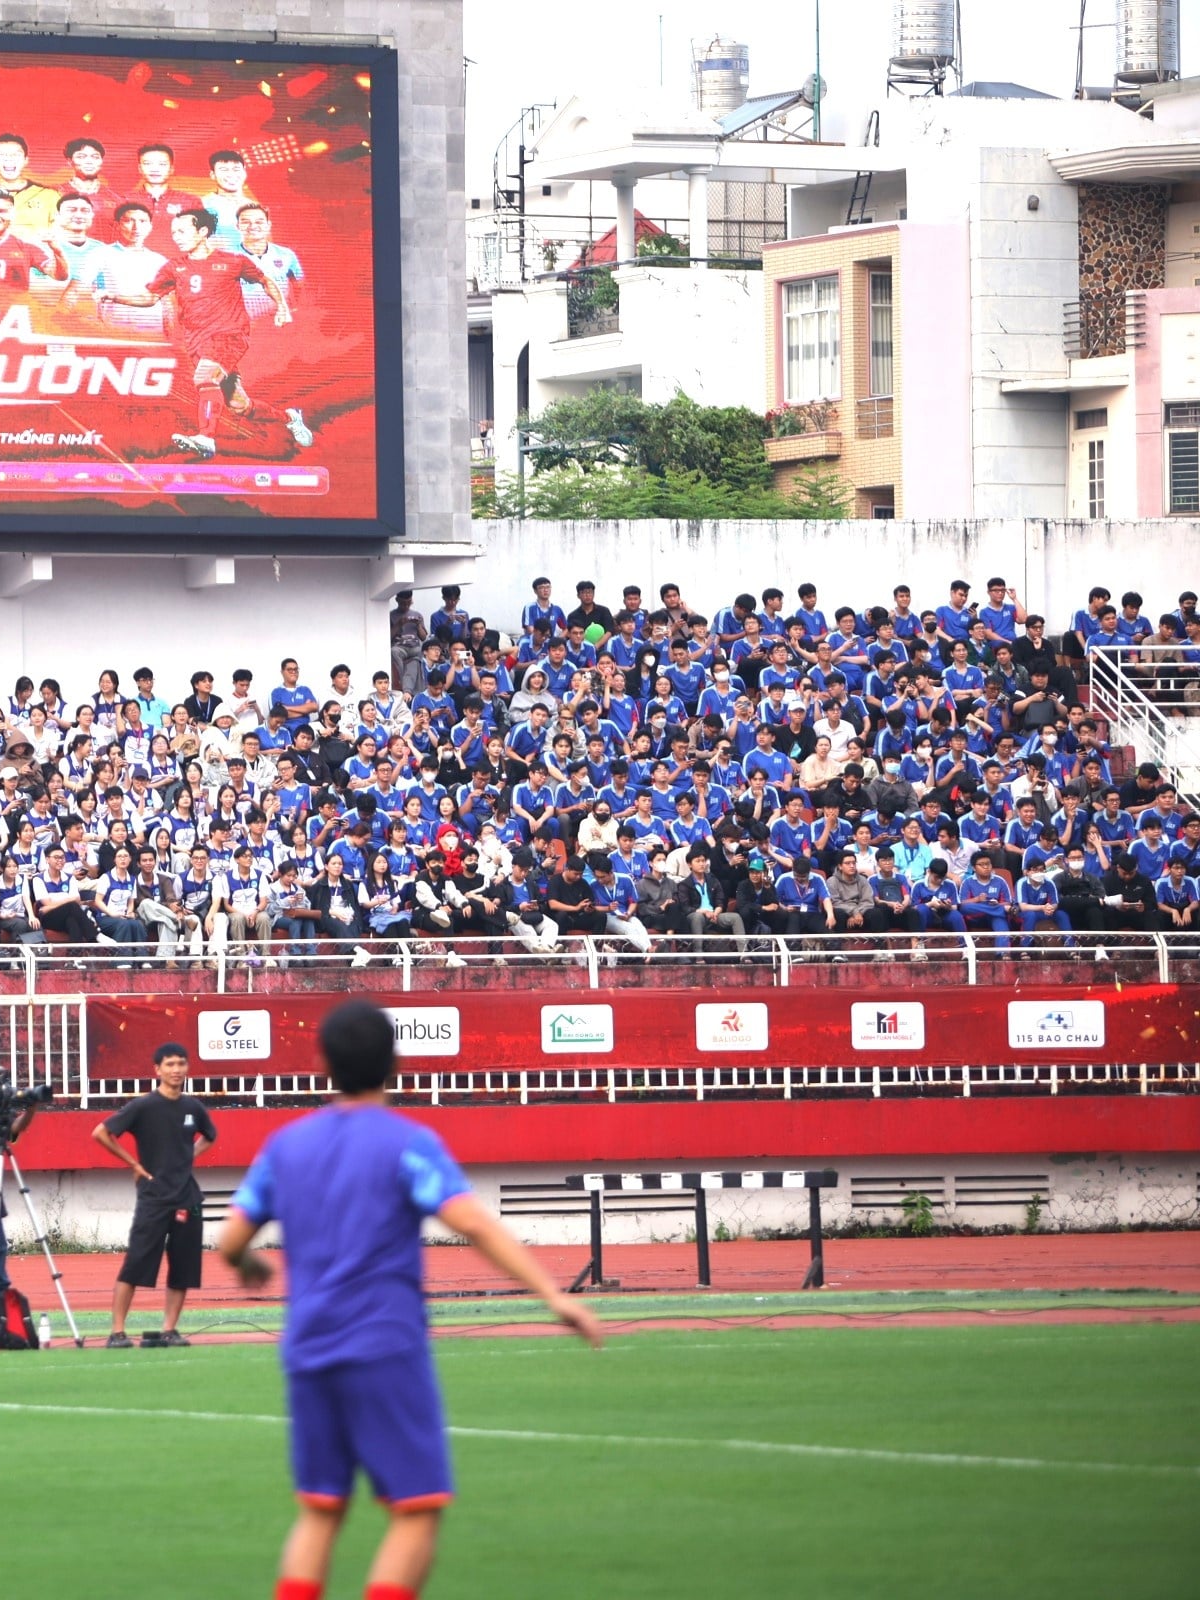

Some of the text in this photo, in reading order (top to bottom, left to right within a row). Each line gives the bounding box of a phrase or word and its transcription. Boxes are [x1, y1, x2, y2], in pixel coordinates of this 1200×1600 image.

[190, 274, 202, 293] 9
[0, 427, 55, 445] THỐNG
[57, 429, 104, 446] NHẤT
[395, 1018, 452, 1040] inbus
[1016, 1034, 1098, 1043] 115 BAO CHAU
[208, 1039, 259, 1050] GB STEEL
